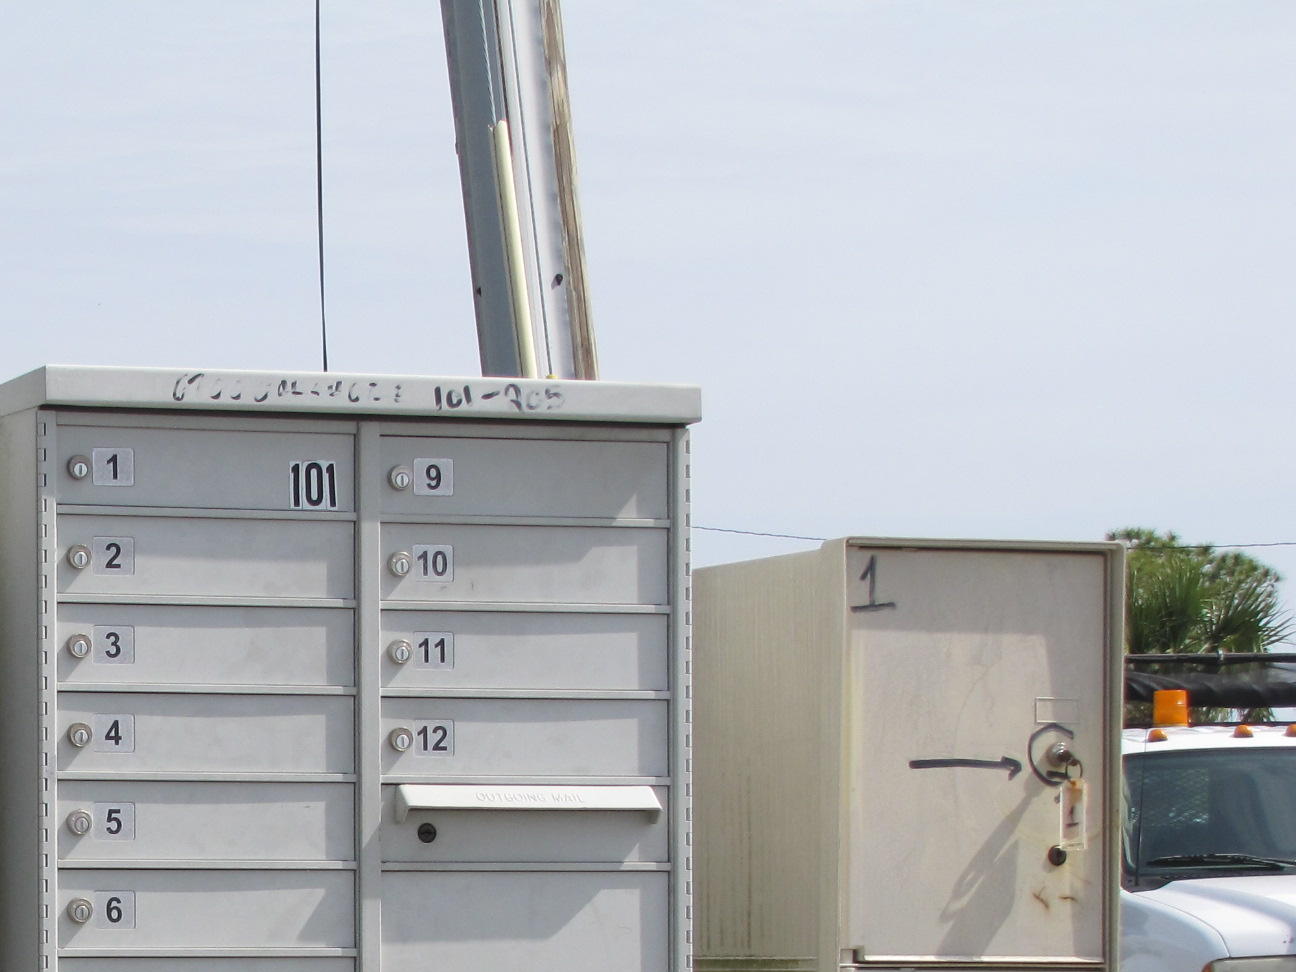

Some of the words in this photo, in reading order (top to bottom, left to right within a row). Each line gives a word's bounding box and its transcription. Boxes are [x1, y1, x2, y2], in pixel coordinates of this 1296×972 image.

[105, 455, 120, 480] 1
[425, 466, 442, 490] 9
[290, 462, 337, 508] 101
[104, 543, 122, 569] 2
[416, 552, 448, 577] 10
[850, 555, 896, 612] 1
[104, 632, 121, 658] 3
[418, 639, 447, 664] 11
[104, 721, 122, 746] 4
[417, 726, 448, 751] 12
[475, 791, 545, 802] OUTGOING
[552, 793, 584, 804] MAIL
[105, 809, 122, 835] 5
[105, 897, 123, 922] 6
